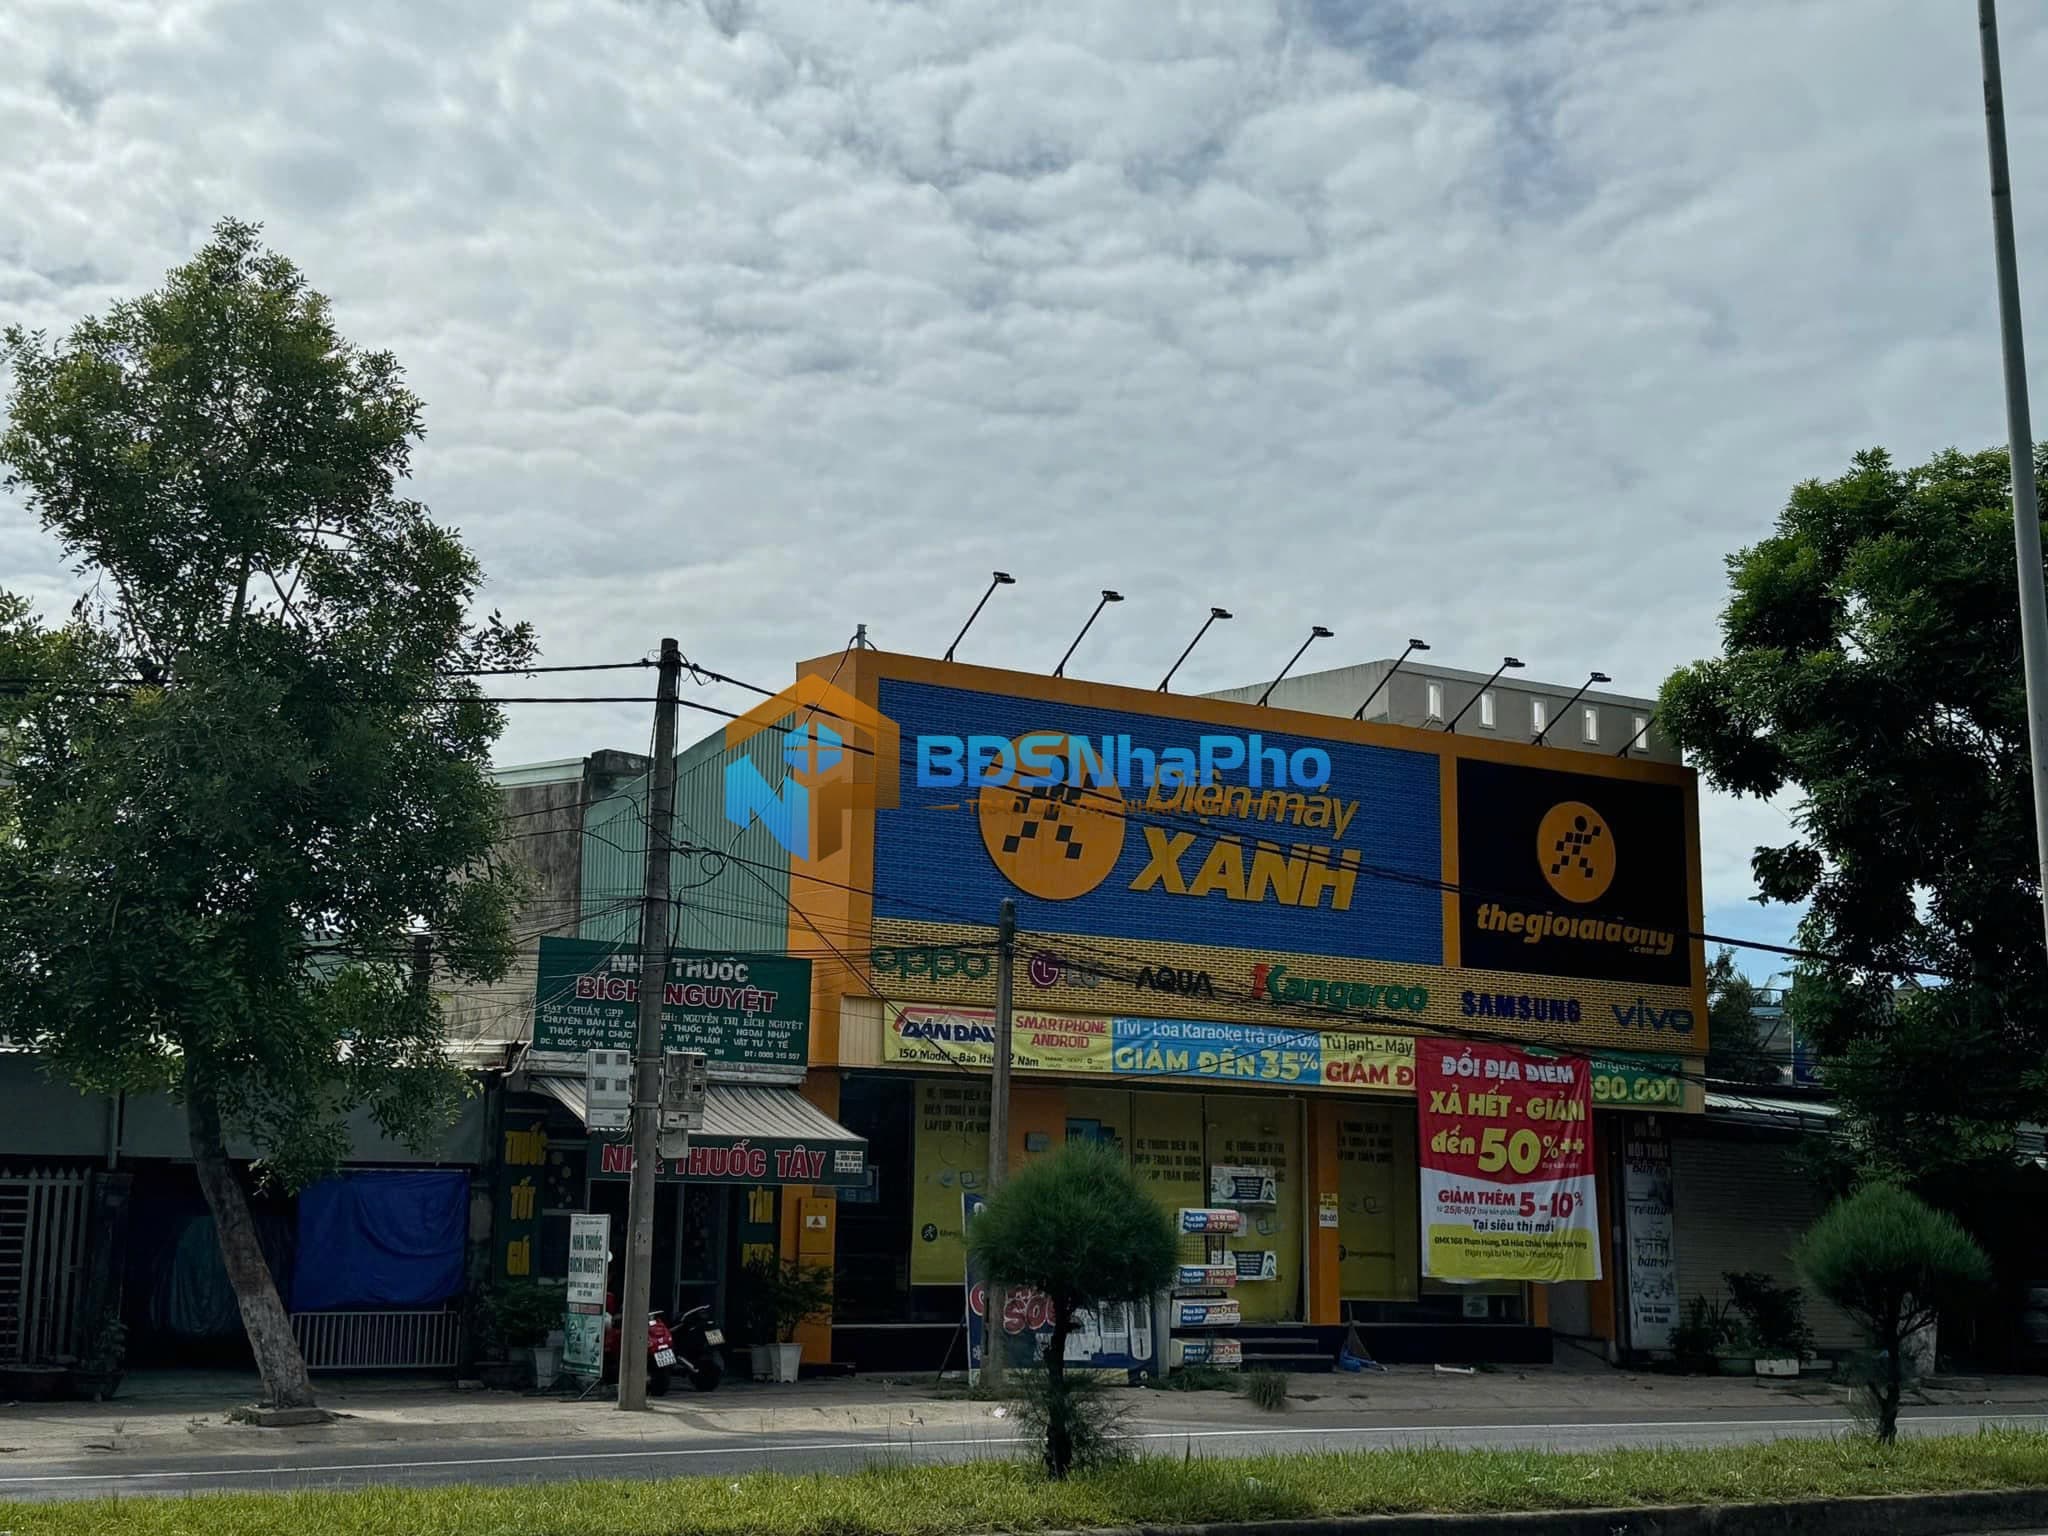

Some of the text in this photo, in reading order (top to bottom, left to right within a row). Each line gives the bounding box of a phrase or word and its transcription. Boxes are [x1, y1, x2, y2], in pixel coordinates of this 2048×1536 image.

[1252, 783, 1361, 841] máy
[1127, 825, 1362, 912] XANH
[609, 954, 644, 974] NH
[871, 945, 990, 982] oppo
[576, 970, 779, 1018] BÍCH NGUYỆT
[1136, 966, 1214, 999] AQUA
[1250, 963, 1428, 1012] Kangaroo
[1462, 991, 1581, 1022] SAMSUNG
[1611, 997, 1694, 1033] vivo
[1015, 1015, 1107, 1034] SMARTPHONE
[1114, 1019, 1141, 1036] Tivi
[1153, 1020, 1180, 1038] Loa
[1183, 1023, 1243, 1042] Karaoke
[1245, 1028, 1265, 1044] trả
[1267, 1030, 1296, 1049] góp
[1031, 1034, 1090, 1049] ANDROID
[1323, 1035, 1341, 1050] Tủ
[1344, 1035, 1374, 1055] lạnh
[1385, 1038, 1414, 1057] Máy
[1115, 1040, 1189, 1071] GIẢM
[1195, 1045, 1257, 1077] ĐẾN
[1259, 1050, 1319, 1081] 35%
[1326, 1055, 1390, 1085] GIẢM
[1442, 1047, 1480, 1078] ĐỔI
[1484, 1058, 1521, 1085] ĐỊA
[1429, 1084, 1463, 1115] XẢ
[1467, 1083, 1512, 1118] HẾT
[1526, 1090, 1586, 1121] GIẢM
[1430, 1124, 1476, 1155] đến
[775, 1144, 827, 1179] TÂY
[1438, 1185, 1475, 1204] GIẢM
[1478, 1188, 1516, 1207] THÊM
[1519, 1191, 1536, 1217] 5
[1473, 1219, 1554, 1234] Tại siêu thị mới
